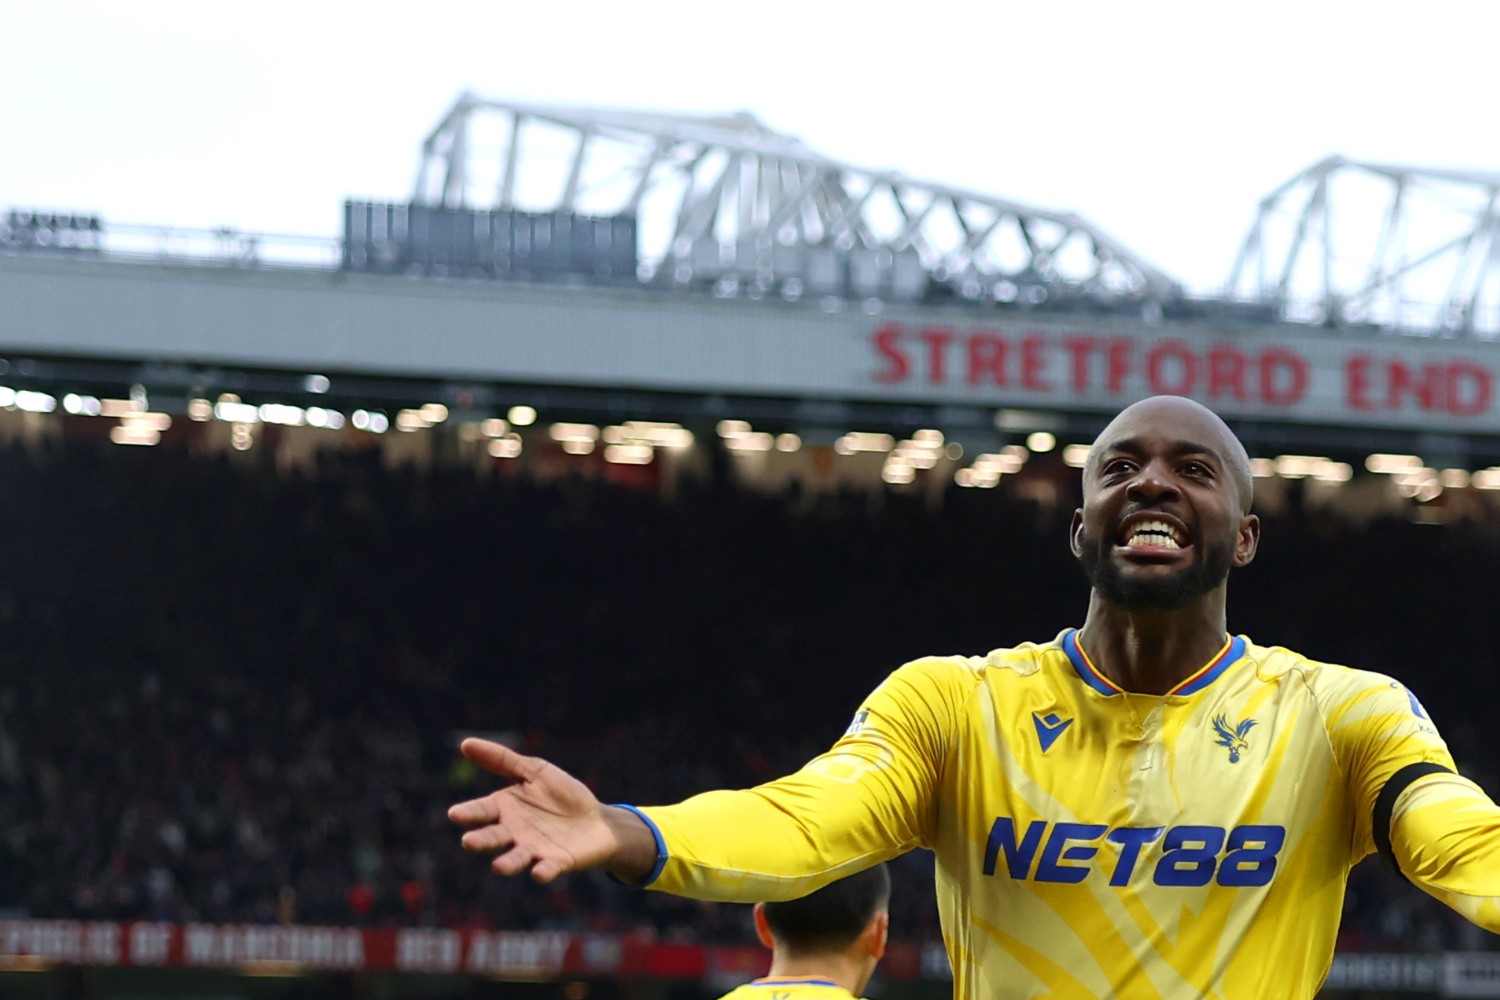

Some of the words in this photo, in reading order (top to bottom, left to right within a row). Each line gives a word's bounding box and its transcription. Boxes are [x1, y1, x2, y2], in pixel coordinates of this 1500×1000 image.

[871, 330, 1309, 406] STRETFORD
[1343, 353, 1495, 416] END
[983, 816, 1285, 887] NET88
